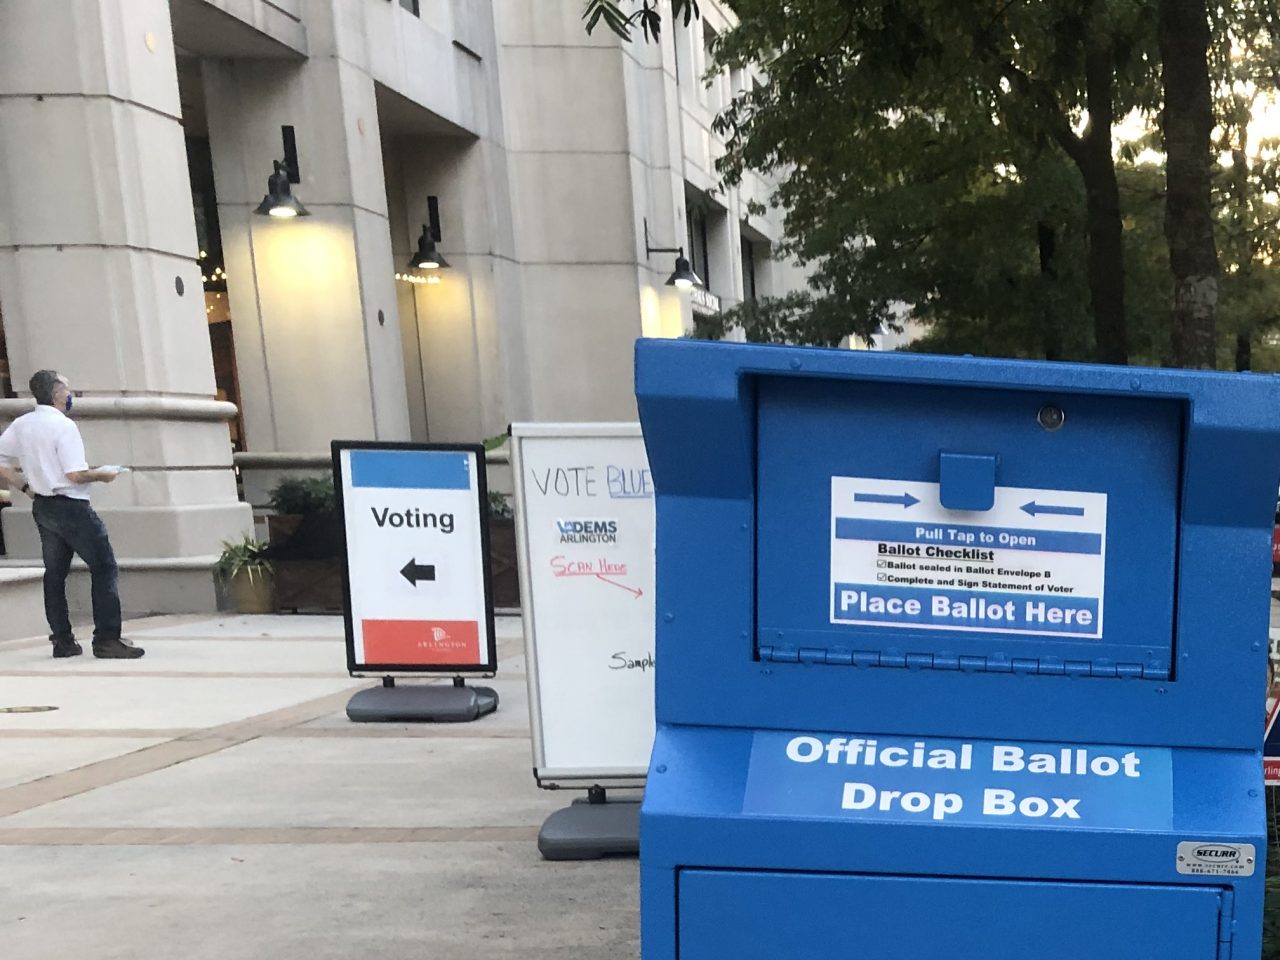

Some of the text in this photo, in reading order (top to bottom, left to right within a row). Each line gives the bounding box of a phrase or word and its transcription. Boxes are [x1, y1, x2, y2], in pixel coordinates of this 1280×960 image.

[532, 465, 654, 496] VOTE BLUE
[371, 507, 455, 534] Voting
[560, 533, 617, 544] ARLINGTON
[916, 527, 1036, 546] Pull Tap to Open
[878, 543, 994, 560] Ballot Checklist
[887, 562, 916, 570] Ballot
[919, 564, 951, 572] sealed
[966, 566, 994, 575] Ballot
[997, 568, 1041, 579] Envelope
[887, 575, 1074, 593] Complete and Sign Statement of Voter
[840, 590, 1093, 625] Place Ballot Here
[417, 641, 467, 649] ARLINGTON
[785, 736, 1141, 777] Official Ballot
[842, 782, 1081, 820] Drop Box
[1196, 850, 1237, 858] SECURR
